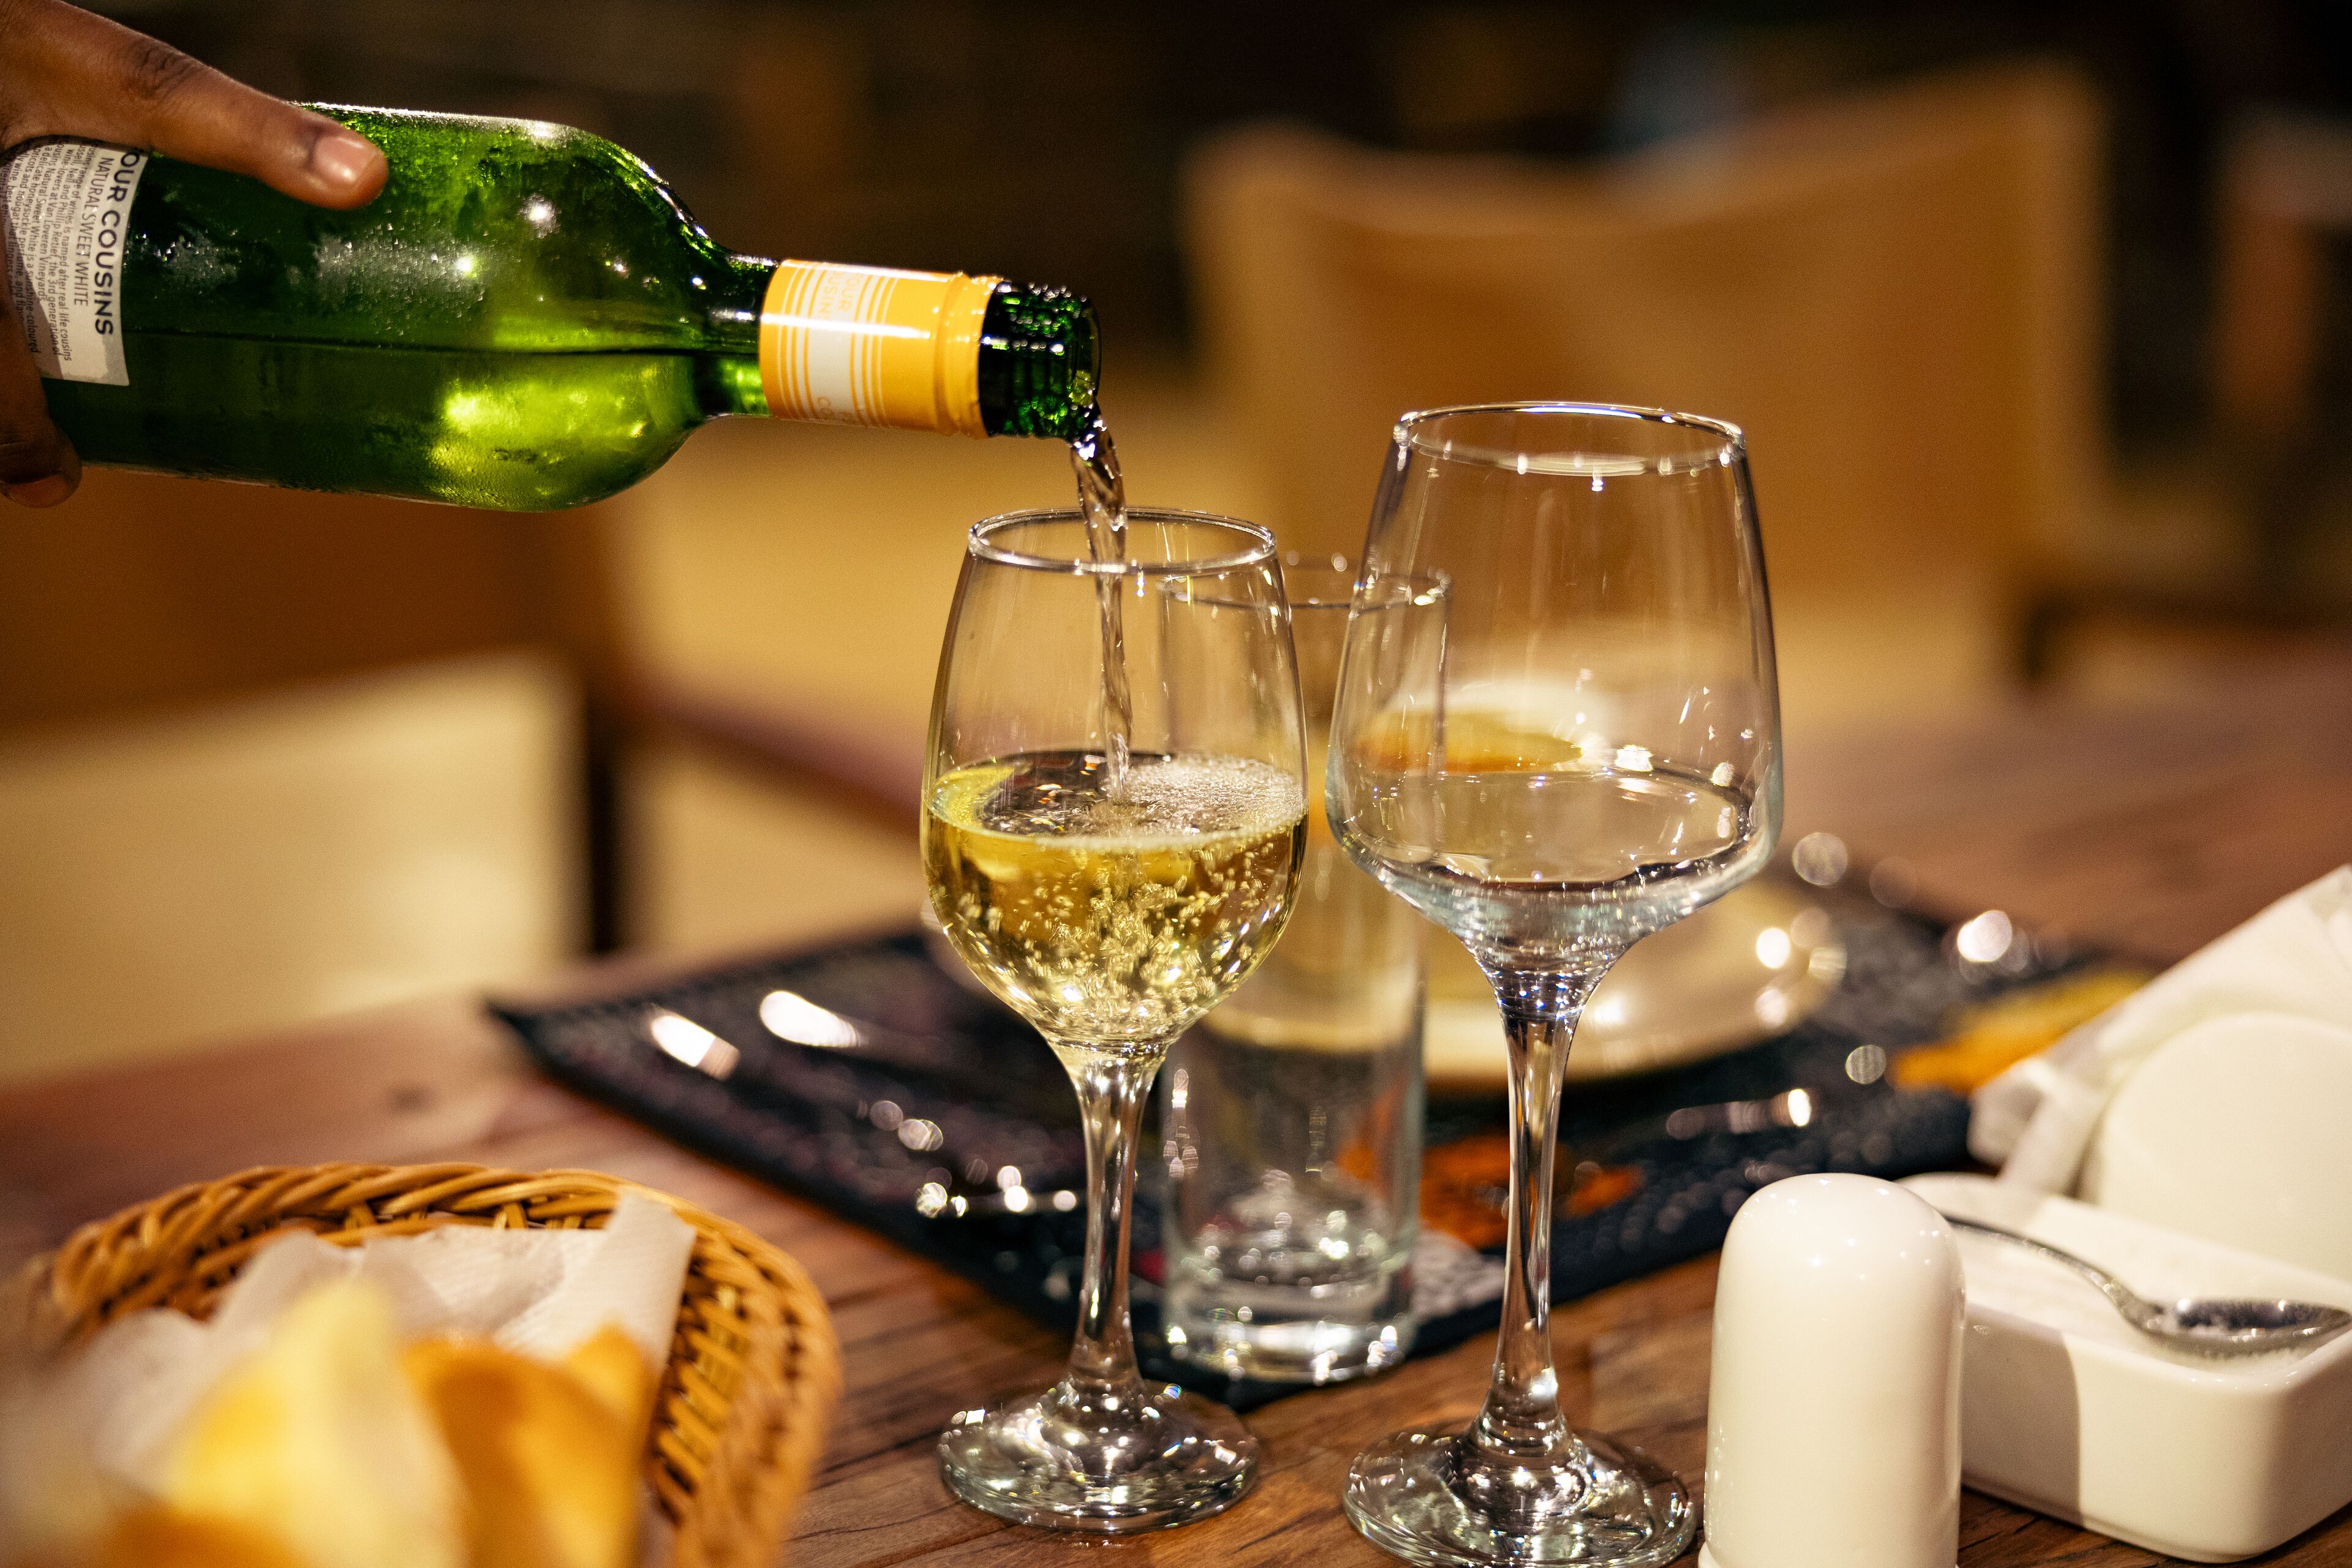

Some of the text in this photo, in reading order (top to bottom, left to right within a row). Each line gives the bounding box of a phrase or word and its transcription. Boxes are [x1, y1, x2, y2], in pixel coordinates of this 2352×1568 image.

[48, 141, 66, 166] ousins
[71, 143, 87, 165] ussell,
[83, 144, 99, 168] ousins
[7, 163, 22, 183] wine,
[32, 153, 51, 181] delicate
[52, 149, 75, 190] wine-lovers
[68, 168, 78, 183] Neil
[75, 168, 88, 189] range
[20, 174, 30, 189] and
[39, 168, 56, 196] Natural
[60, 185, 71, 199] and
[12, 191, 24, 221] nougat
[20, 183, 39, 235] honeysuckle
[32, 198, 45, 223] Sweet
[46, 203, 57, 217] Van
[53, 202, 67, 229] Phillip
[64, 201, 78, 225] wines
[28, 226, 40, 251] White
[40, 220, 54, 254] Loveren
[74, 157, 114, 306] NATURAL SWEET WHITE
[94, 152, 140, 335] OUR COUSINS
[59, 236, 70, 266] named
[49, 262, 58, 276] the
[58, 270, 69, 290] after
[15, 281, 26, 298] and
[48, 279, 58, 294] 3rd
[47, 297, 60, 345] generation
[60, 330, 72, 361] cousins
